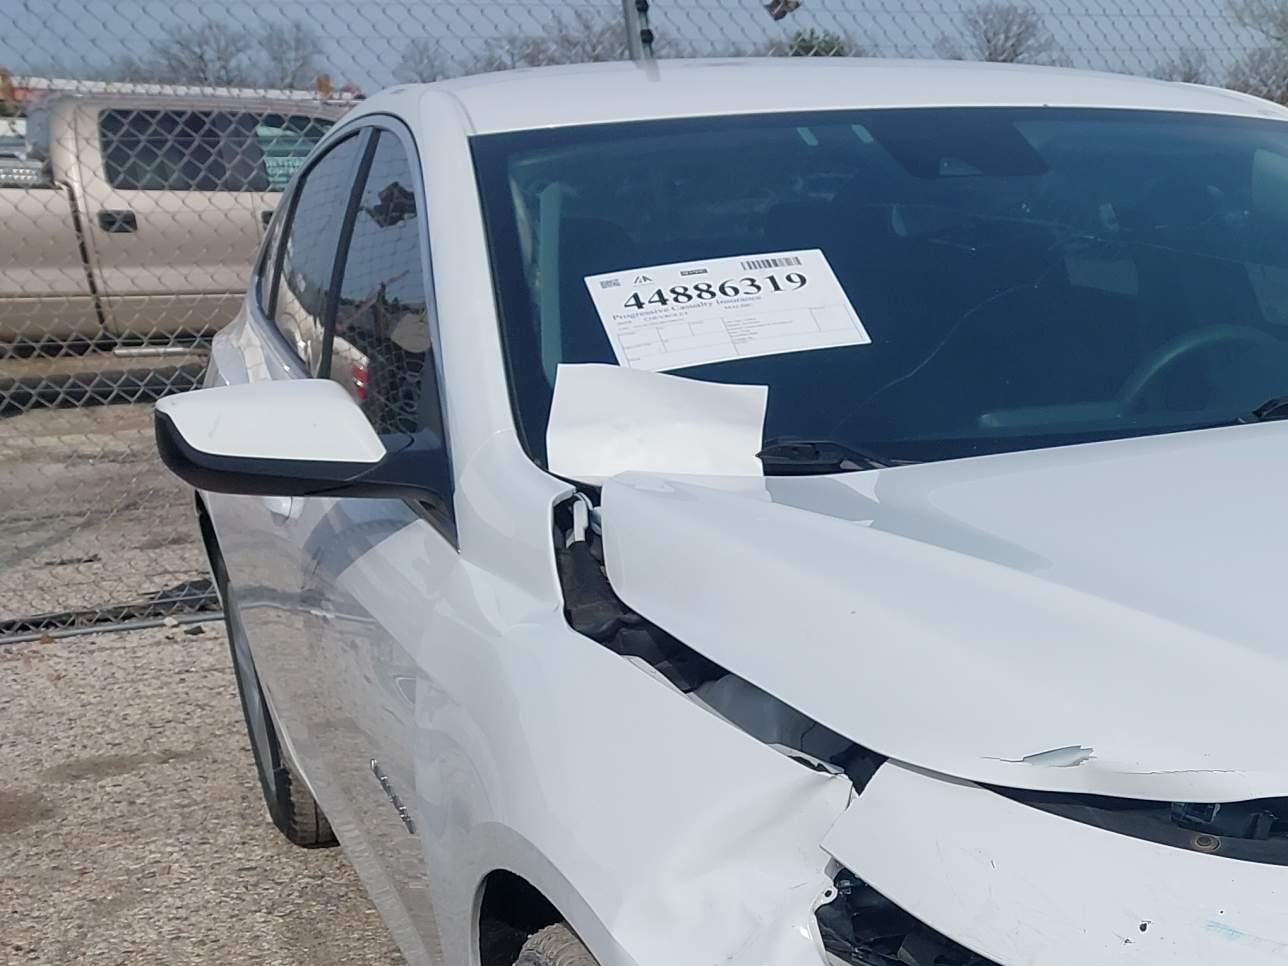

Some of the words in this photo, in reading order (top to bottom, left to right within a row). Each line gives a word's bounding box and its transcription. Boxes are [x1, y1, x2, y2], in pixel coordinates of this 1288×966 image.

[624, 272, 807, 310] 44886319
[612, 306, 669, 320] Progressive
[671, 301, 713, 313] Casualty
[716, 295, 762, 305] Insurance
